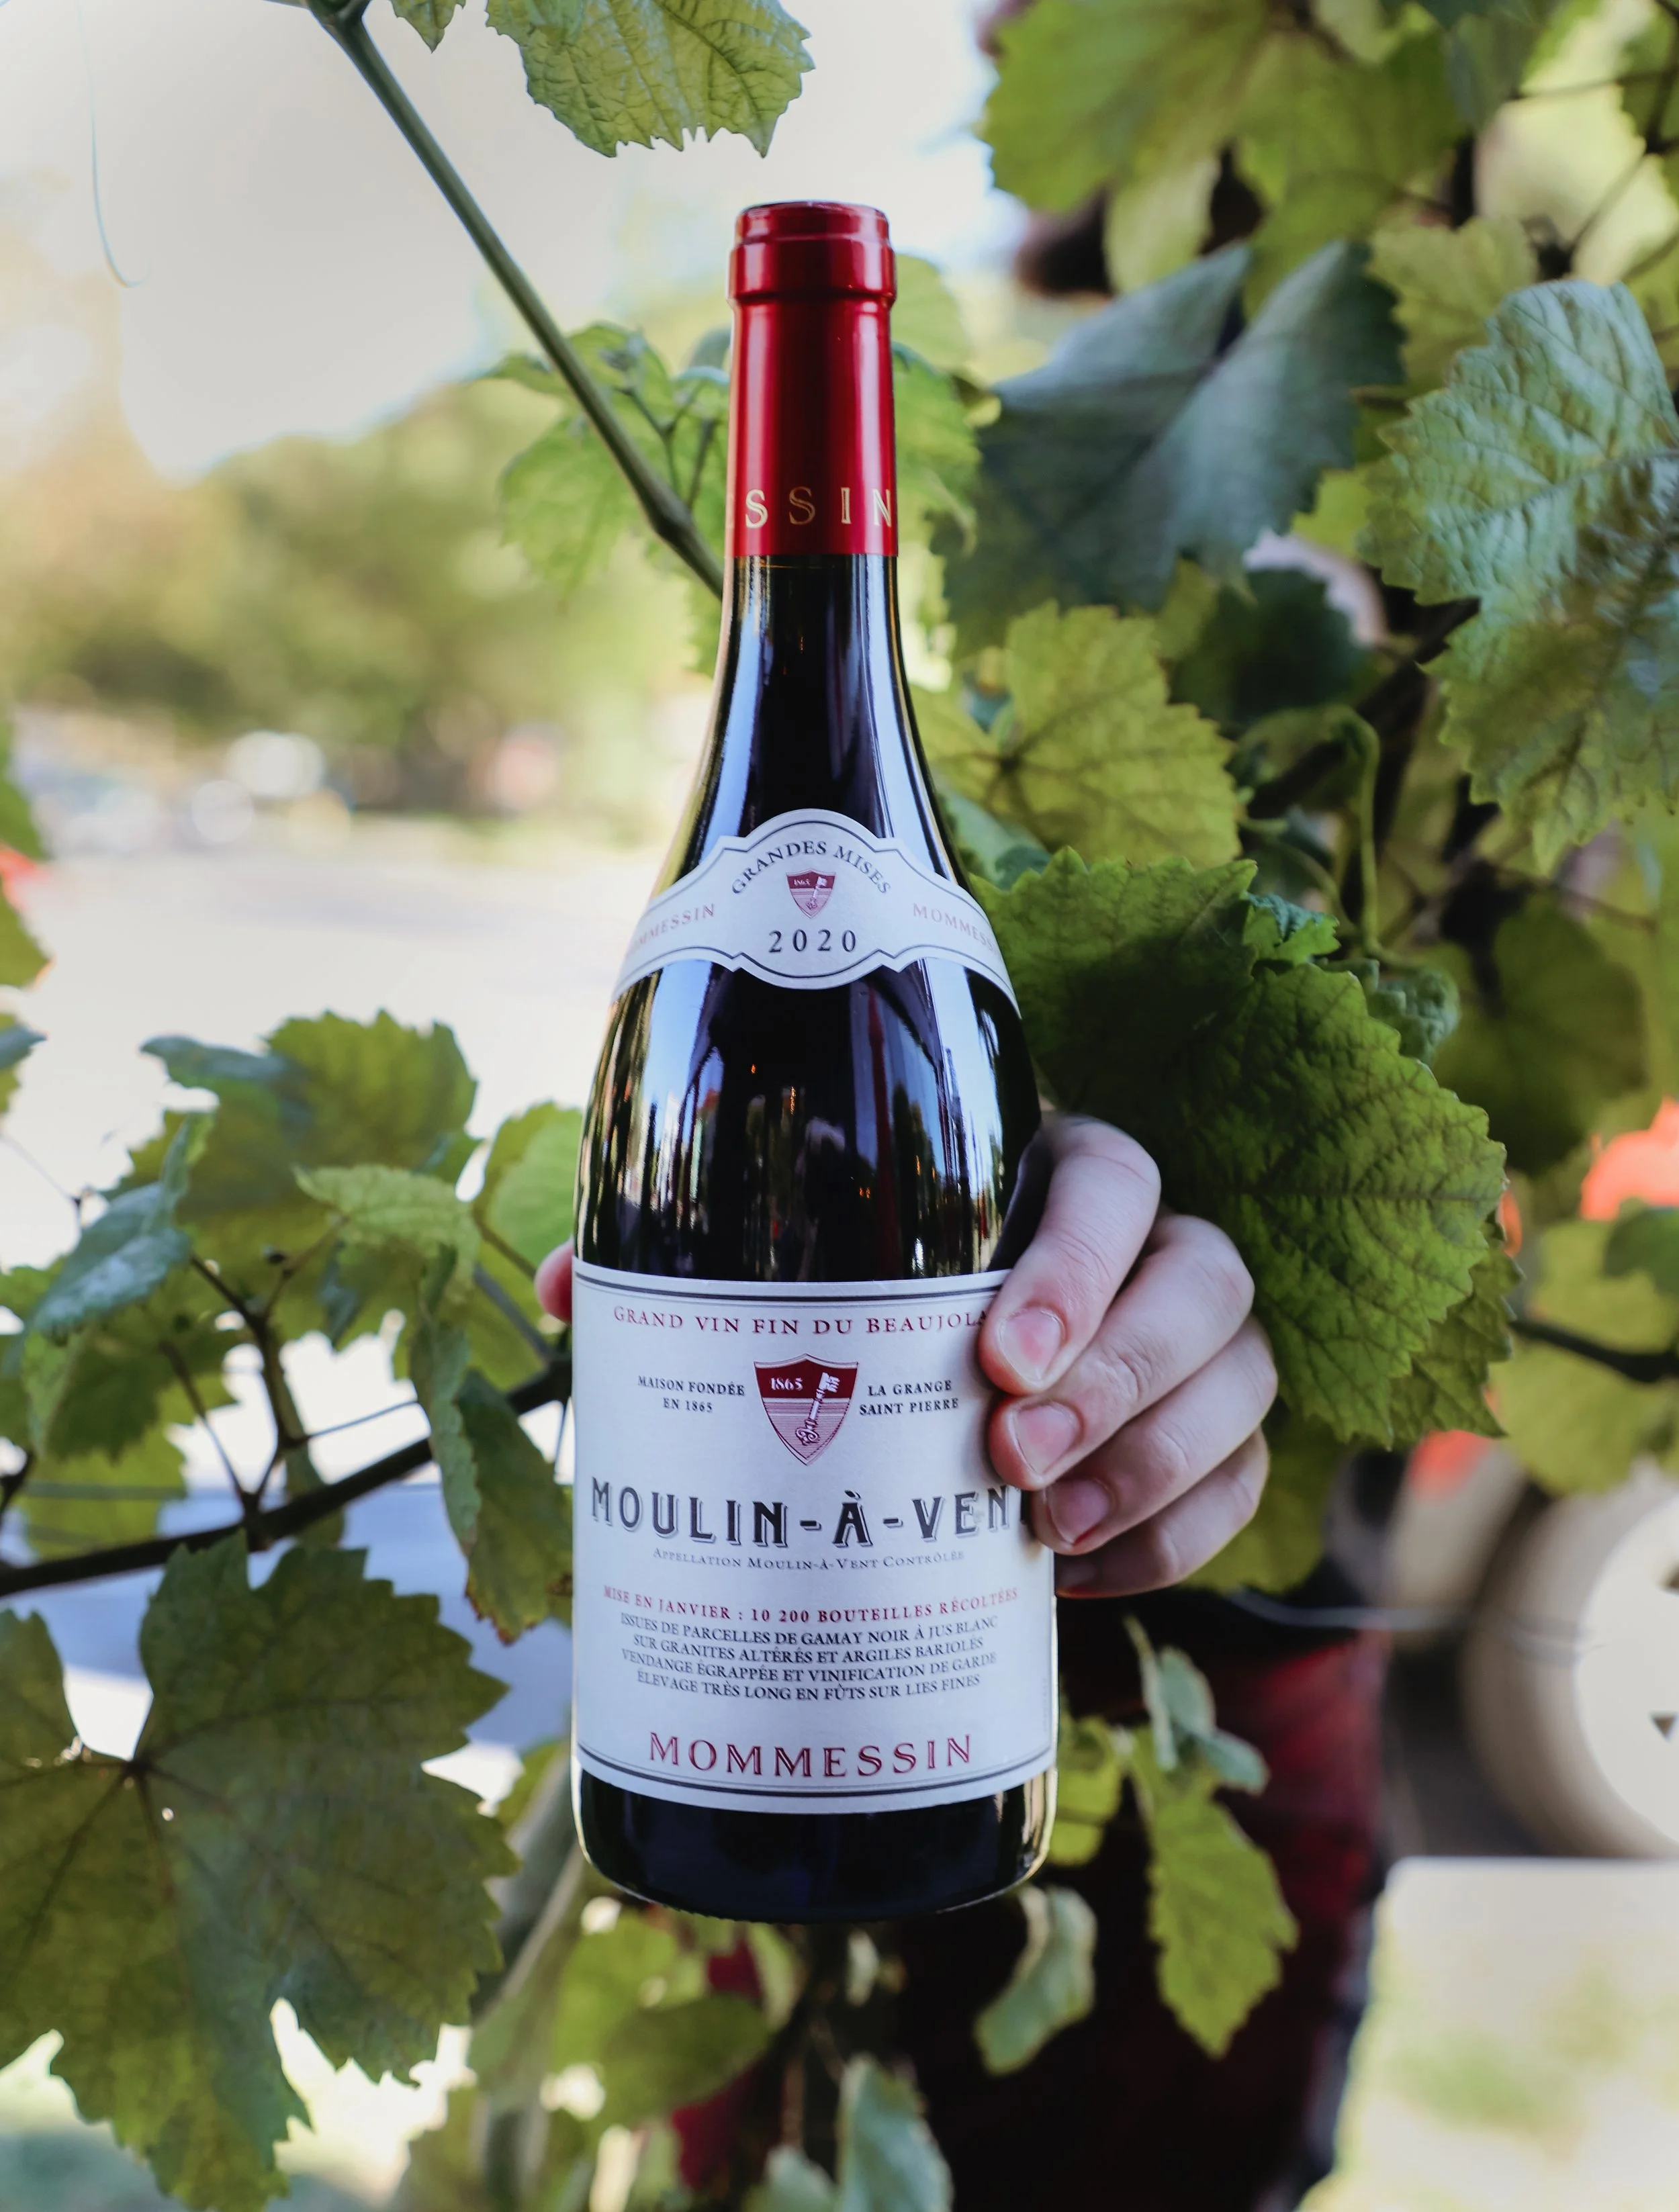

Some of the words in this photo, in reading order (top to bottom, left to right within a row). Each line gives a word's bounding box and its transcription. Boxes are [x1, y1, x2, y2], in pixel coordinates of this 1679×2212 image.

[745, 486, 893, 529] SSIN
[731, 839, 827, 894] GRANDES
[833, 844, 892, 894] MISES
[768, 929, 857, 954] 2020
[614, 1305, 684, 1329] GRAND
[694, 1316, 740, 1333] VIN
[752, 1318, 799, 1335] FIN
[813, 1318, 854, 1335] DU
[638, 1375, 684, 1392] MAISON
[687, 1381, 746, 1397] FONDÉE
[770, 1377, 803, 1391] 1865
[866, 1385, 887, 1397] LA
[892, 1379, 953, 1395] GRANGE
[662, 1396, 680, 1410] EN
[684, 1399, 713, 1413] 1865
[858, 1402, 904, 1416] SAINT
[909, 1397, 960, 1414] PIERRE
[604, 1584, 631, 1604] MISE
[634, 1593, 653, 1609] EN
[658, 1598, 732, 1620] JANVIER
[751, 1608, 770, 1622] 10
[778, 1609, 810, 1624] 200
[817, 1603, 933, 1624] BOUTEILLES
[938, 1587, 1019, 1615] RÉCOLTÉES
[620, 1612, 658, 1632] ISSUES
[661, 1620, 680, 1635] DE
[682, 1624, 772, 1645] PARCELLES
[774, 1631, 798, 1645] DE
[800, 1631, 863, 1646] GAMAY
[867, 1628, 910, 1644] NOIR
[913, 1622, 925, 1641] À
[927, 1622, 953, 1639] JUS
[955, 1614, 999, 1634] BLANC
[633, 1633, 657, 1651] SUR
[660, 1639, 735, 1660] GRANITES
[739, 1646, 813, 1664] ALTÉRÉS
[816, 1651, 839, 1664] ET
[842, 1646, 912, 1663] ARGILES
[915, 1636, 984, 1659] BARIOLÉS
[621, 1647, 694, 1675] VENDANGE
[696, 1657, 779, 1681] ÉGRAPPÉE
[782, 1669, 805, 1682] ET
[807, 1663, 925, 1682] VINIFICATION
[929, 1660, 949, 1675] DE
[951, 1651, 997, 1671] GARDE
[637, 1667, 699, 1694] ÉLEVAGE
[700, 1679, 741, 1697] TRÈS
[744, 1686, 792, 1700] LONG
[795, 1687, 819, 1701] EN
[868, 1684, 901, 1700] SUR
[905, 1679, 939, 1696] LIES
[940, 1673, 981, 1692] FINES
[648, 1731, 971, 1779] MOMMESSIN
